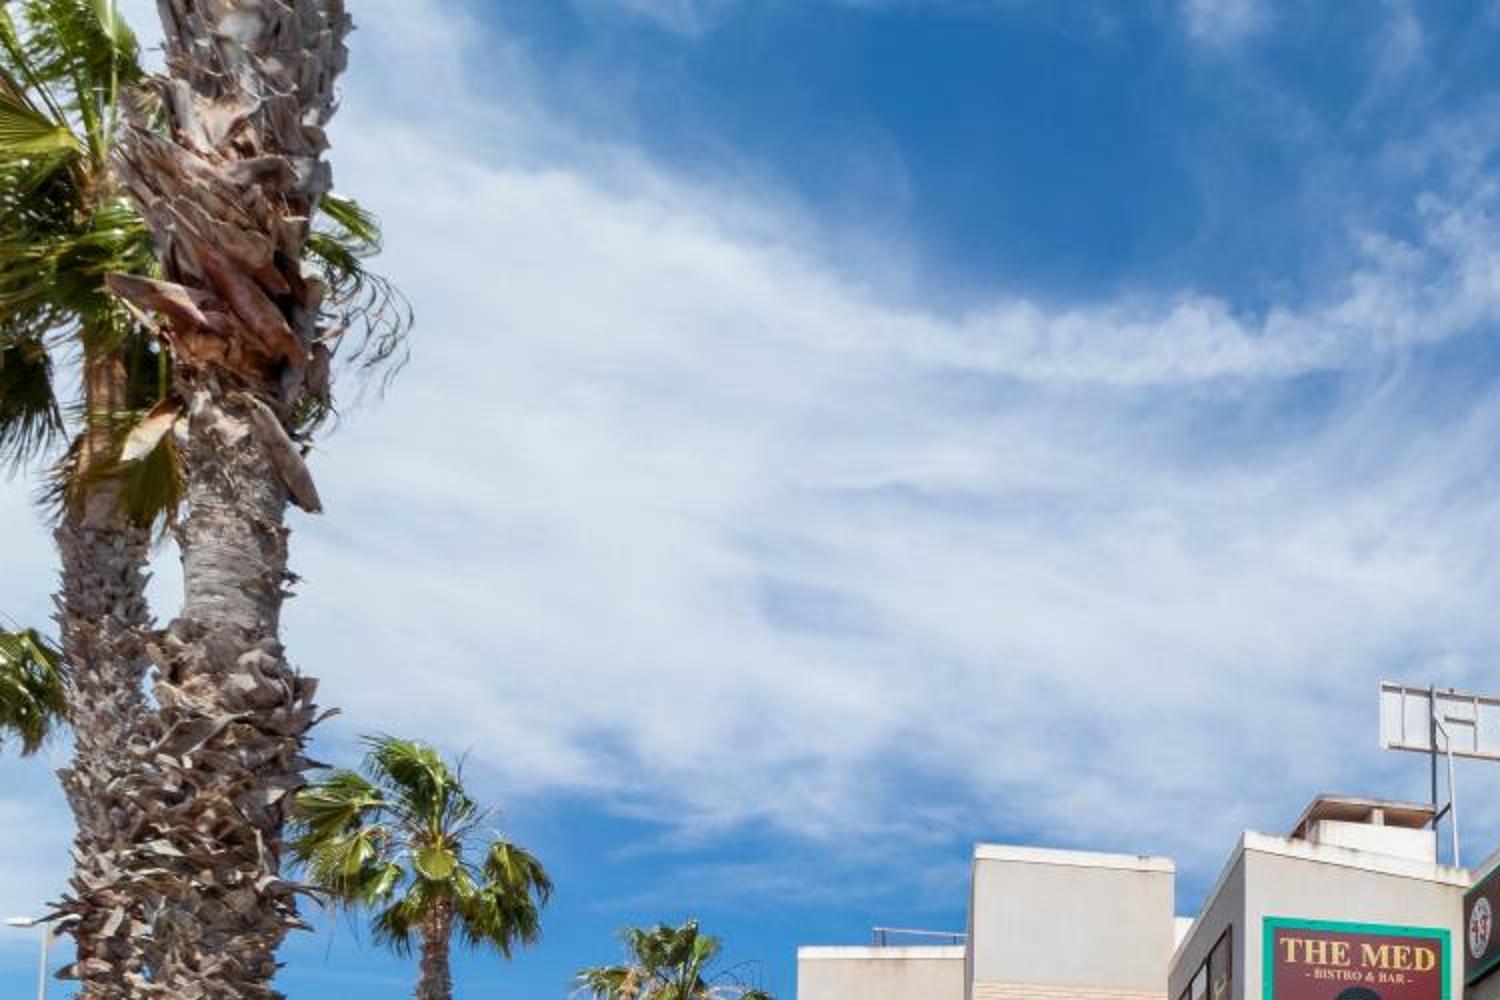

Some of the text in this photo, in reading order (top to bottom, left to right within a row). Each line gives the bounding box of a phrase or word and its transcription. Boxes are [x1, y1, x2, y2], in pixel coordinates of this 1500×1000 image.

[1280, 937, 1436, 971] THE MED
[1314, 968, 1362, 981] BISTRO
[1378, 972, 1405, 984] BAR
